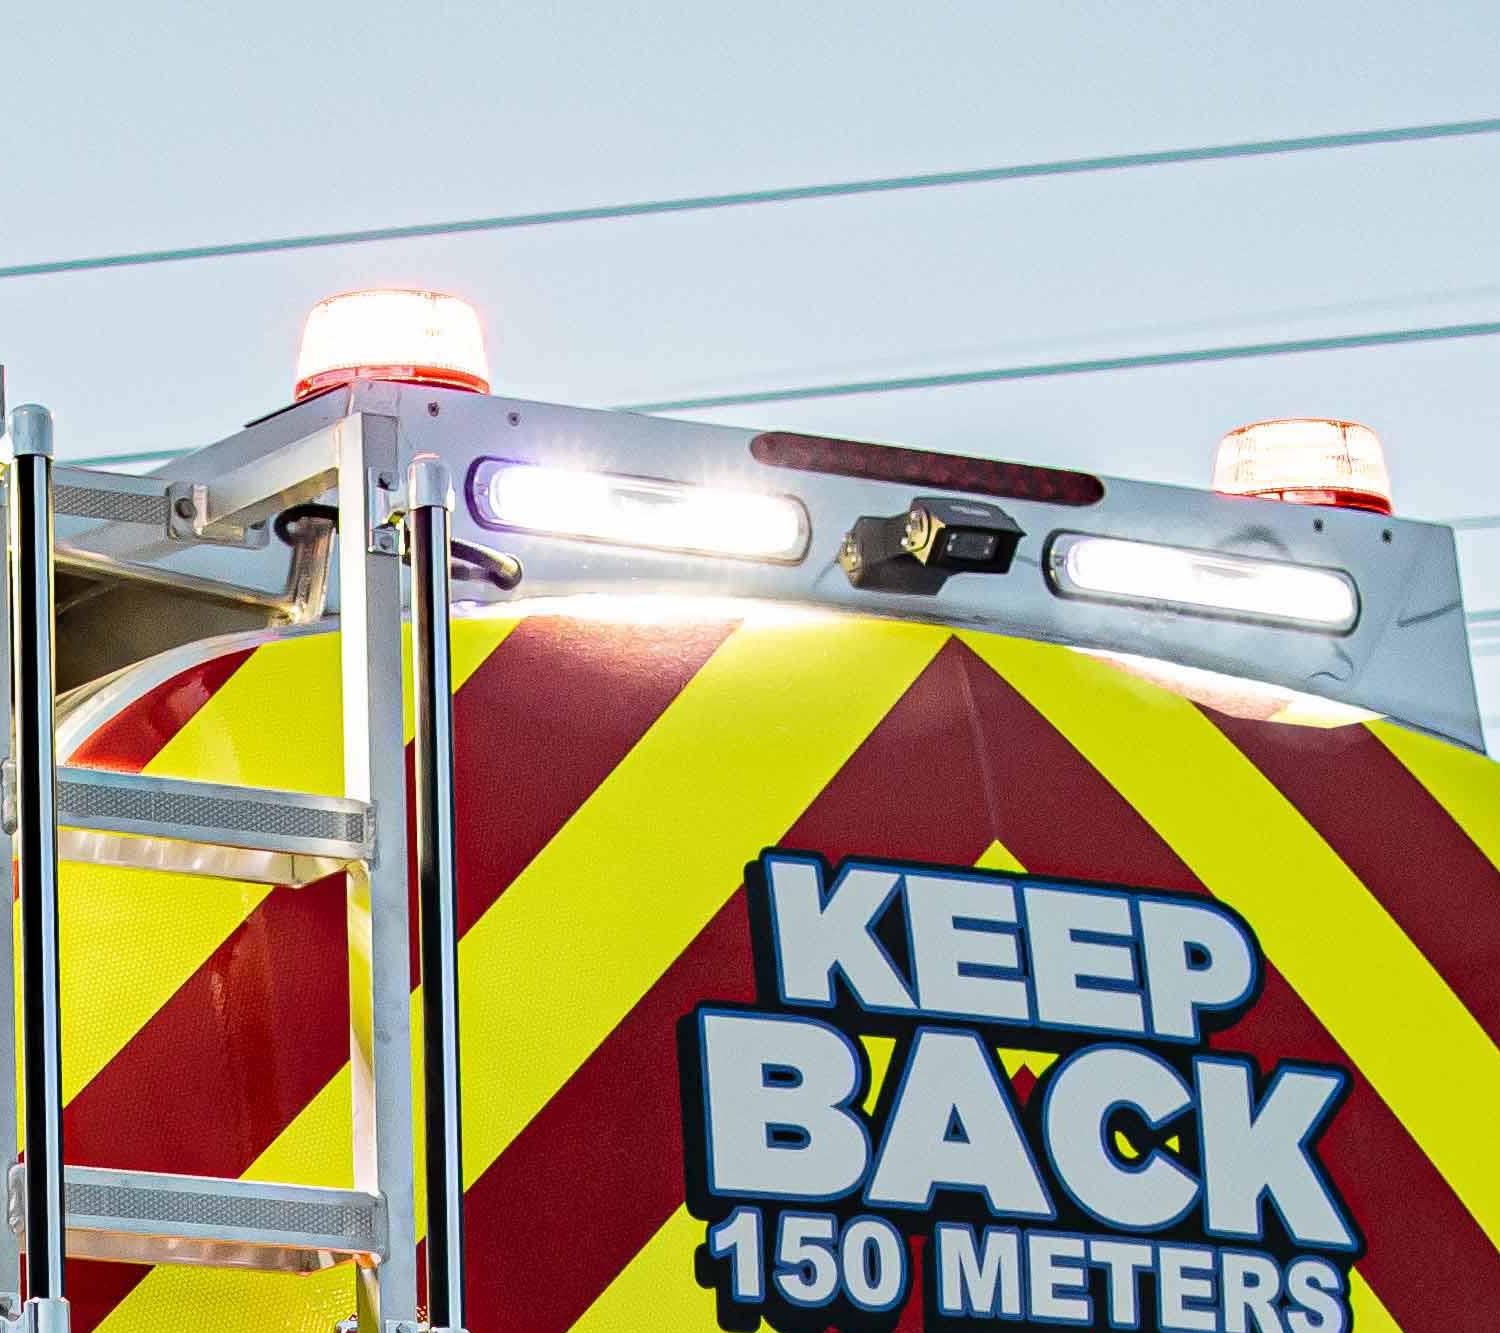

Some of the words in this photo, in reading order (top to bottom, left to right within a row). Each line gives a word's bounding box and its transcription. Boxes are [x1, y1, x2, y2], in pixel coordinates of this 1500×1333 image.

[766, 856, 1256, 1041] KEEP
[699, 1008, 1358, 1251] BACK
[708, 1206, 906, 1310] 150
